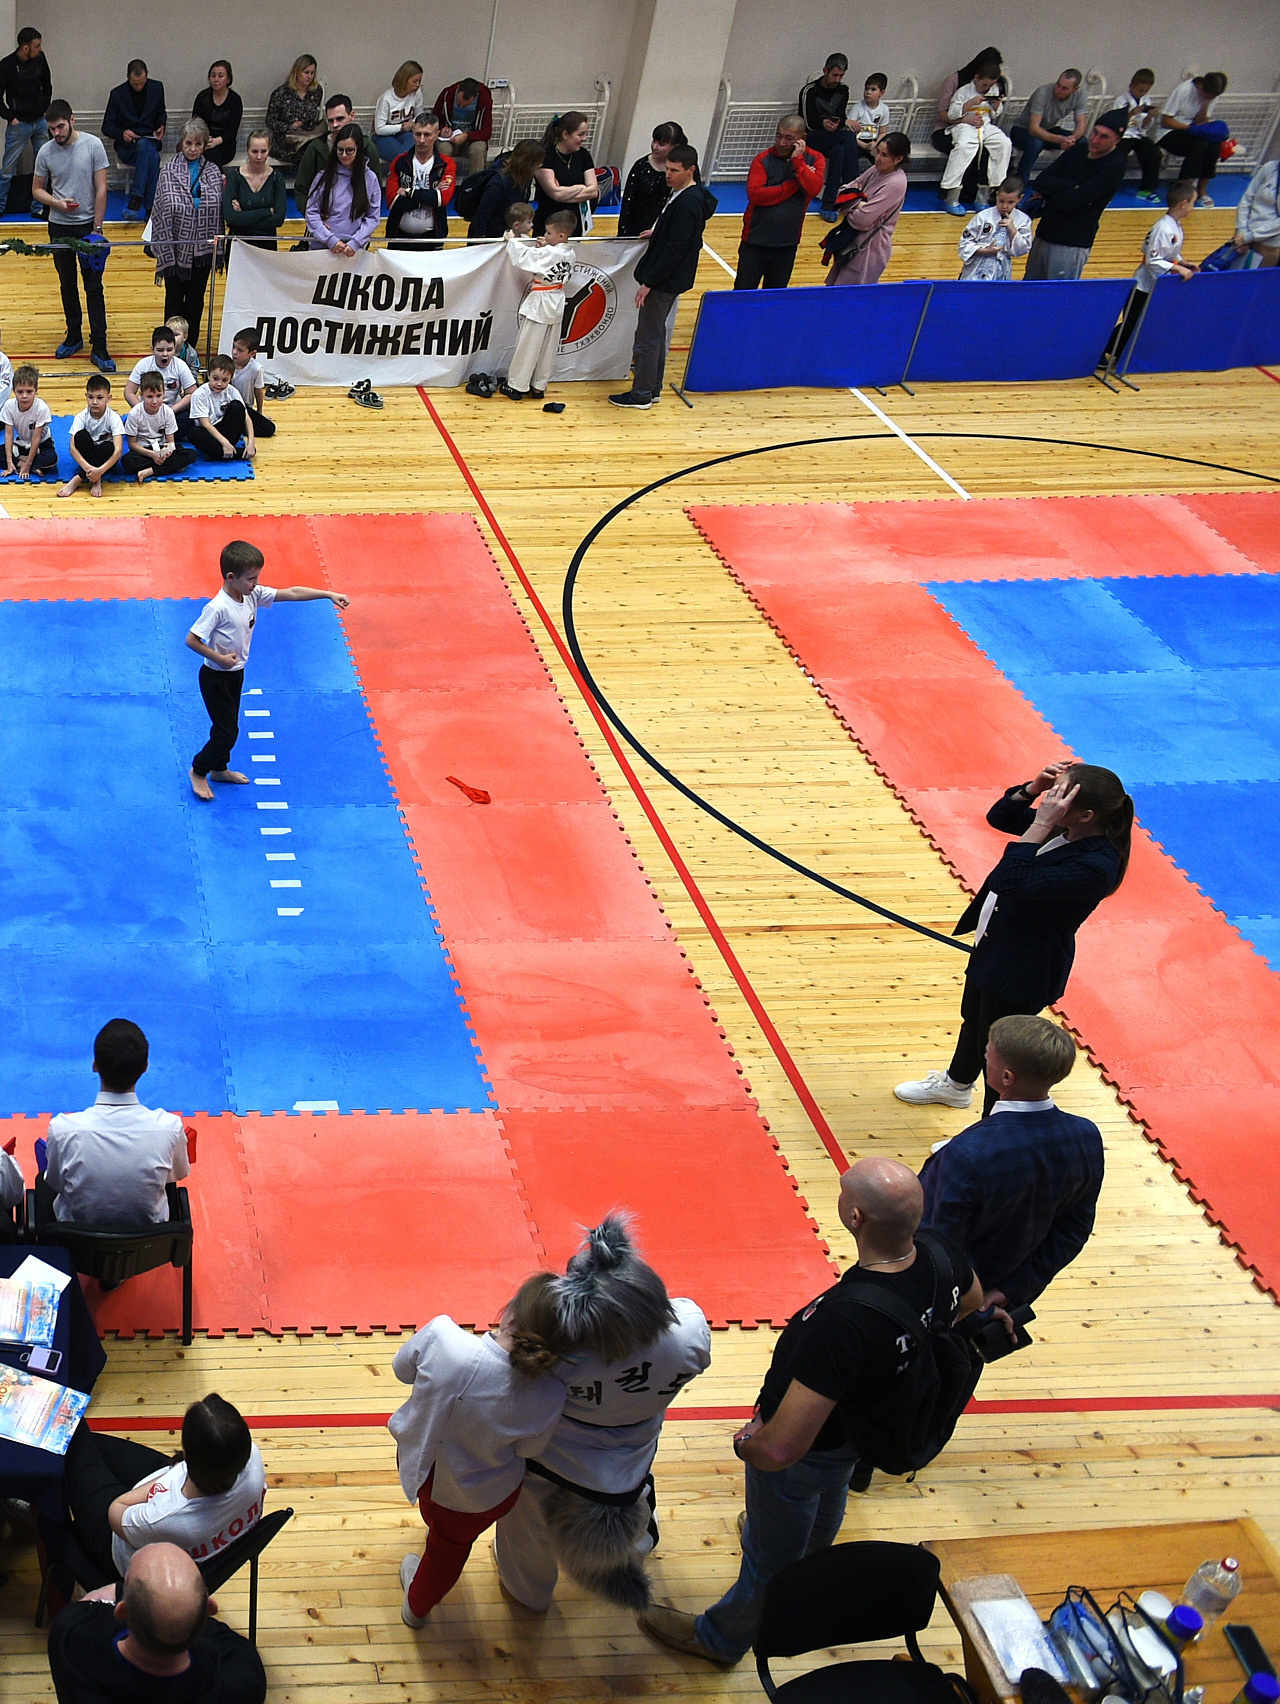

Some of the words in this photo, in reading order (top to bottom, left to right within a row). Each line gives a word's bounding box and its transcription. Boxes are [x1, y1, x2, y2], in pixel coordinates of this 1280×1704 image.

[311, 272, 445, 313] ШКОЛА
[573, 264, 613, 295] СТИЖЕНИЙ
[255, 311, 493, 360] ДОСТИЖЕНИЙ
[575, 306, 614, 349] ТХЭКВОНДО
